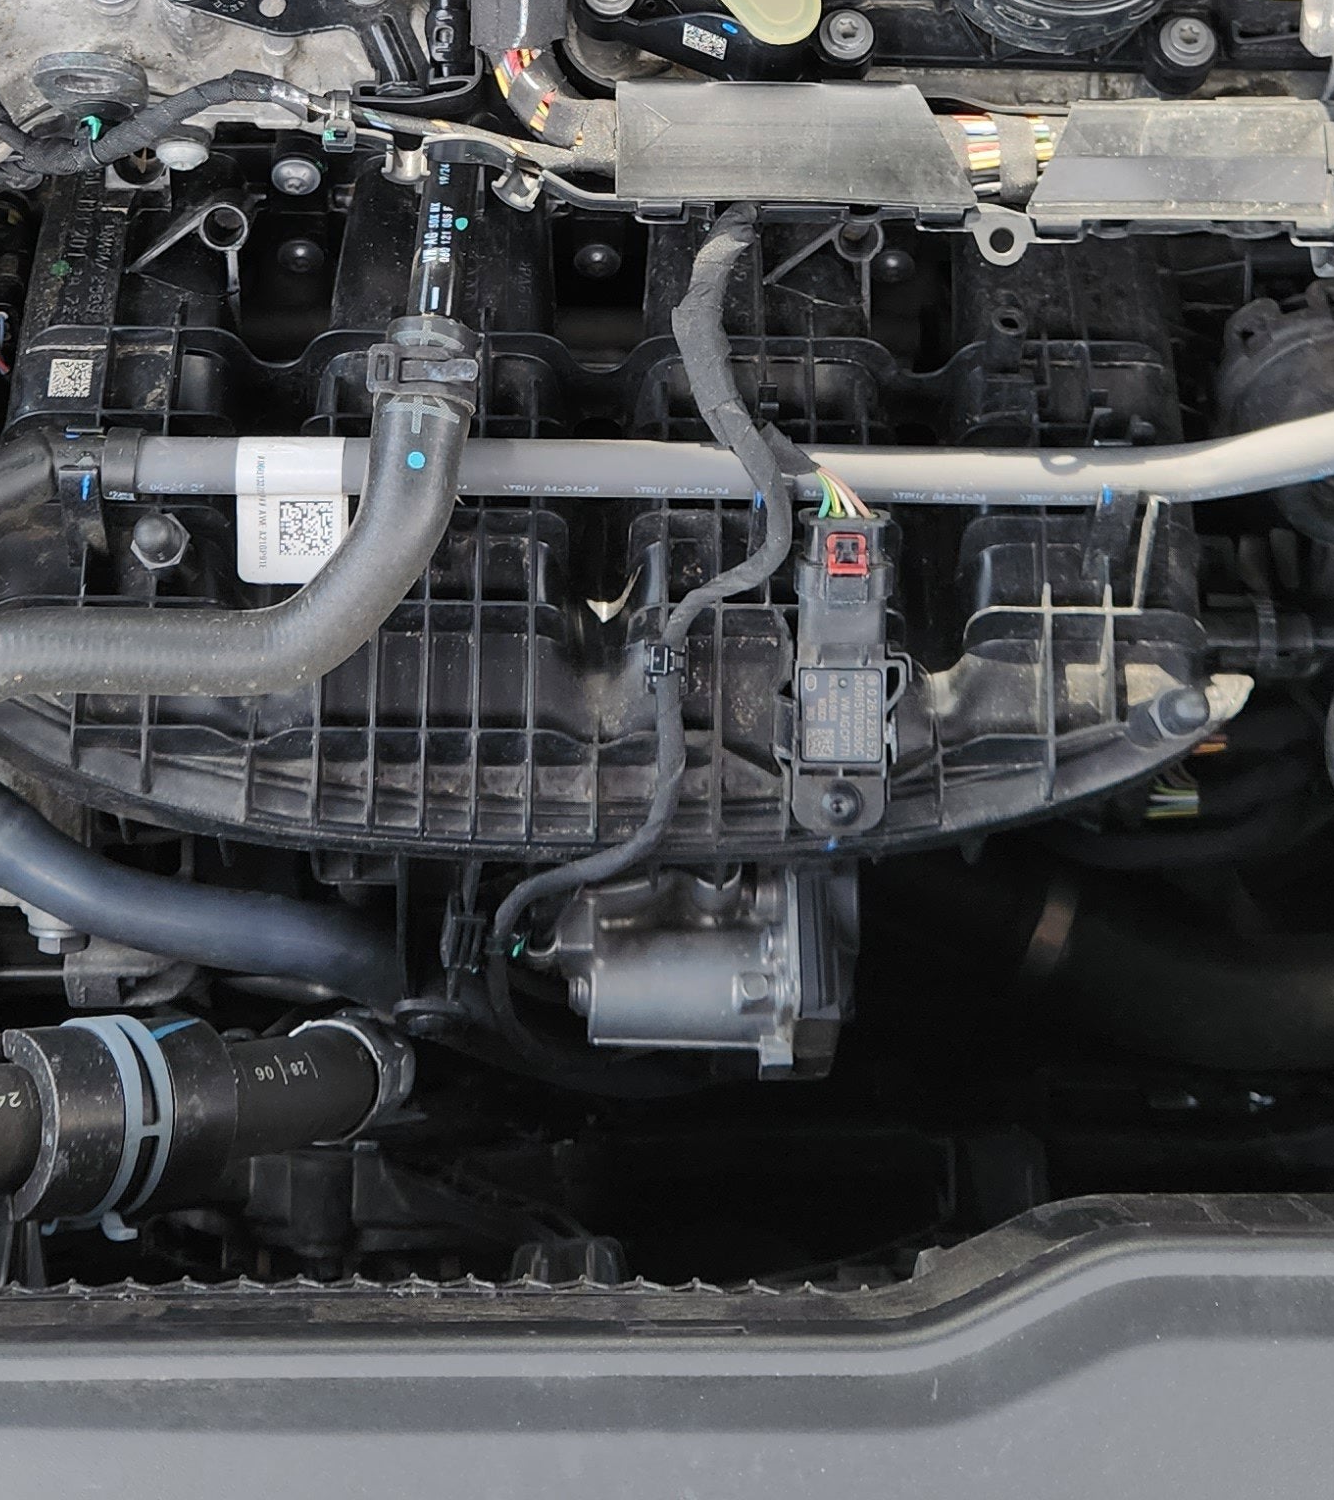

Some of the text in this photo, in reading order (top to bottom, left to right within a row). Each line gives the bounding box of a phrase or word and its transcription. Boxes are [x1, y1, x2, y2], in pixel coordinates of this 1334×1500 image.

[439, 163, 450, 184] 19/24
[424, 231, 438, 244] AG
[440, 230, 451, 244] 121
[866, 688, 877, 696] 0
[866, 718, 876, 738] 230
[866, 740, 876, 759] 572
[254, 1066, 276, 1083] 06
